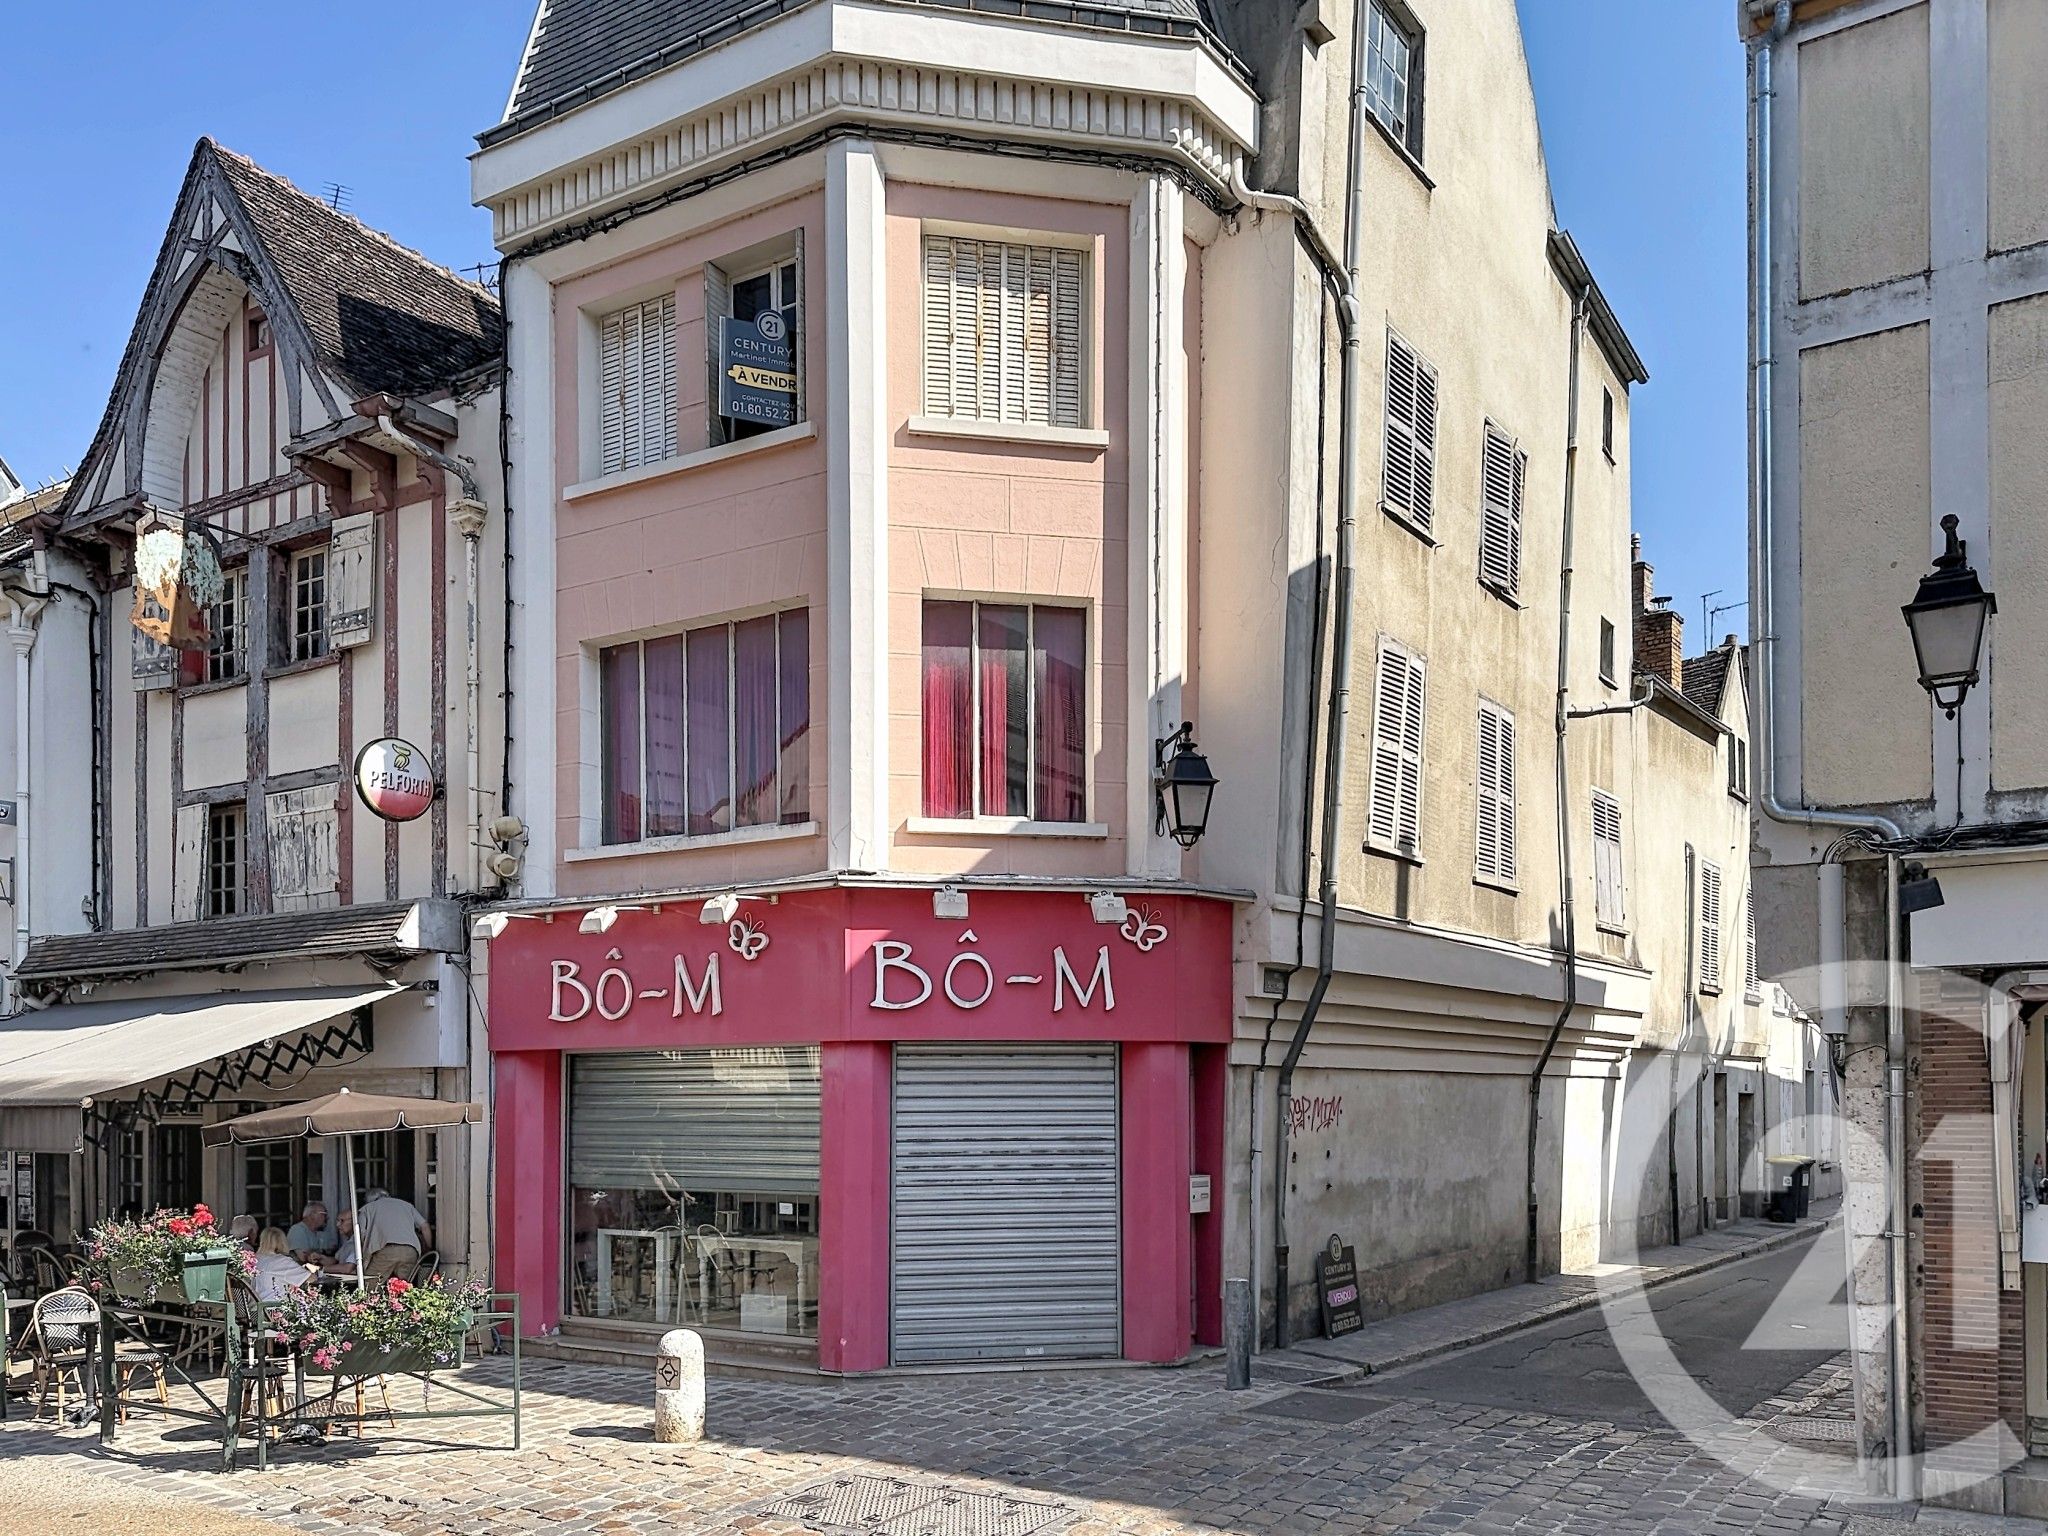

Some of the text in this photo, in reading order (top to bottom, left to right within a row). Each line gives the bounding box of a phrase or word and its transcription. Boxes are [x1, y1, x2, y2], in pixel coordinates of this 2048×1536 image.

[765, 321, 778, 334] 21
[734, 338, 793, 357] CENTURY
[737, 367, 747, 381] À
[370, 770, 432, 798] PELFORTH
[1333, 1290, 1352, 1303] VENDU
